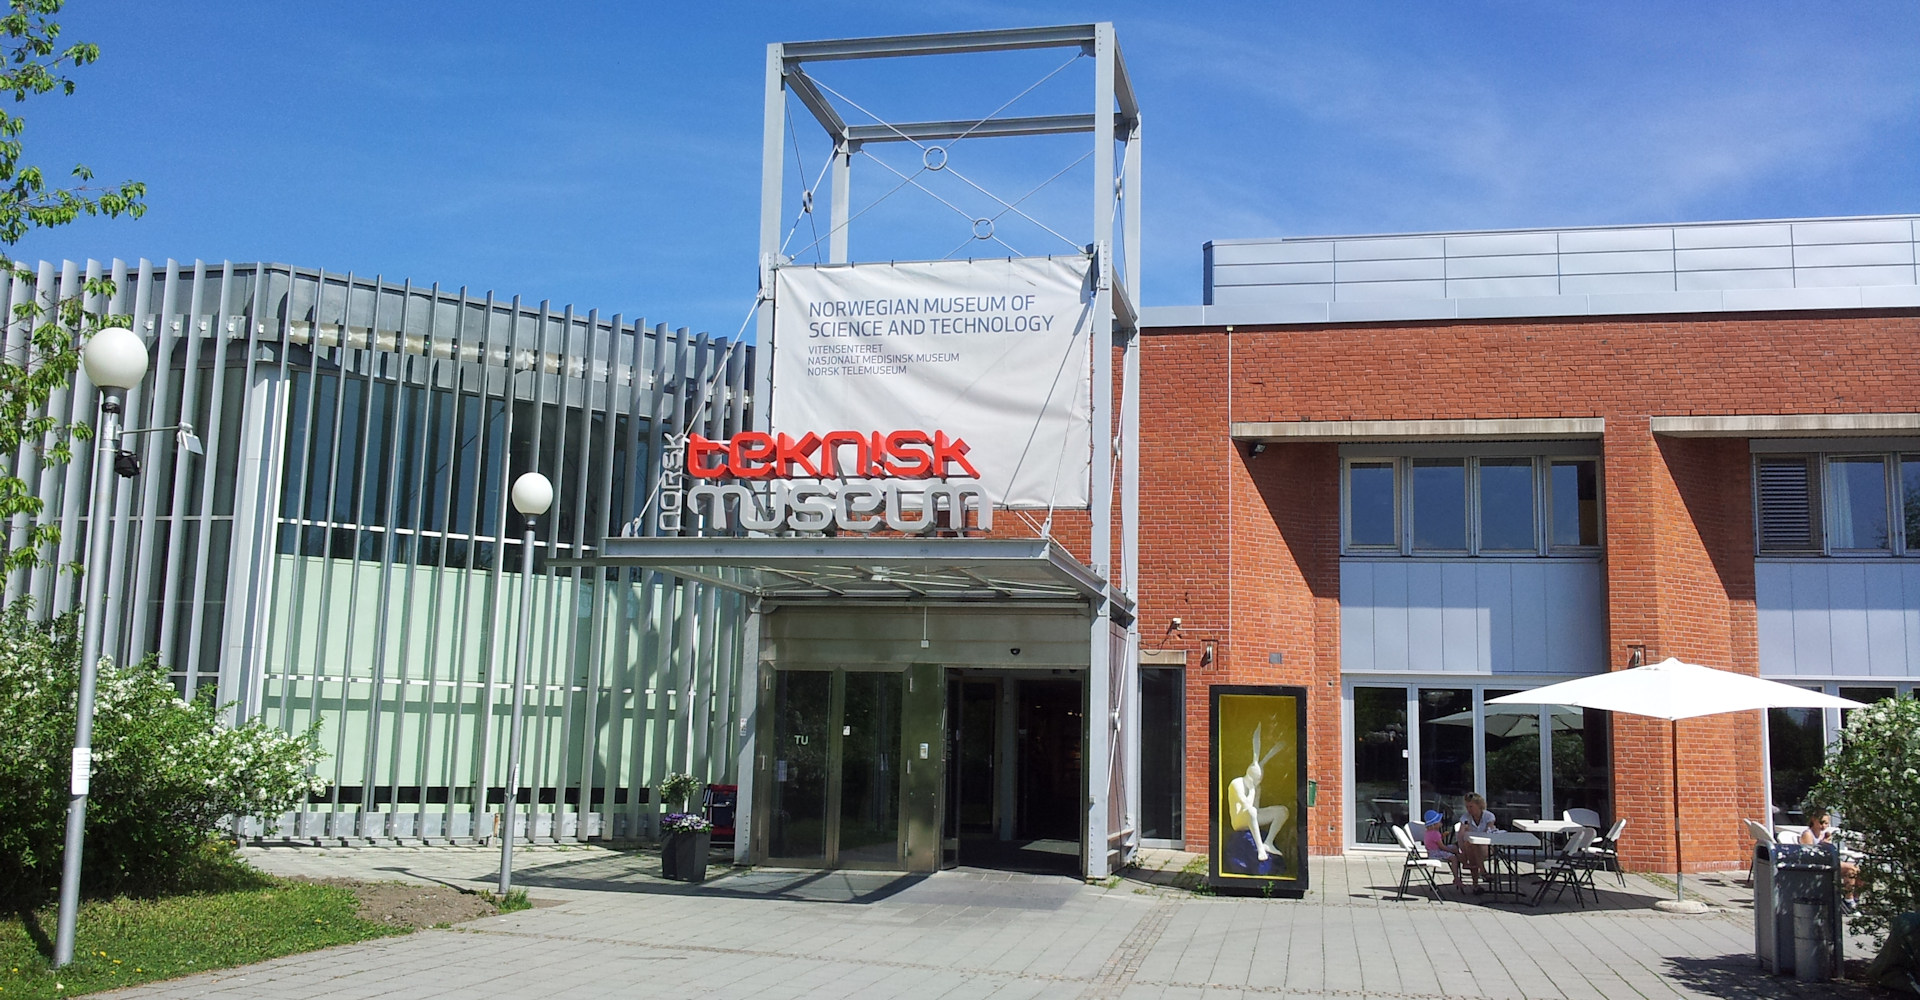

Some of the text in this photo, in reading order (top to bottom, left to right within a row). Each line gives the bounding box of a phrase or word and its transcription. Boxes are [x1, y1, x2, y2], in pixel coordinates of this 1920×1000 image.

[809, 295, 1035, 317] NORWEGIAN MUSEUM OF
[809, 315, 1054, 338] SCIENCE AND TECHNOLOGY
[808, 344, 883, 354] VITENSENTERET
[807, 353, 960, 365] NASJONALT MEDISINSK MUSEUM
[807, 365, 907, 376] NORSK TELEMUSEUM
[794, 735, 808, 745] TU
